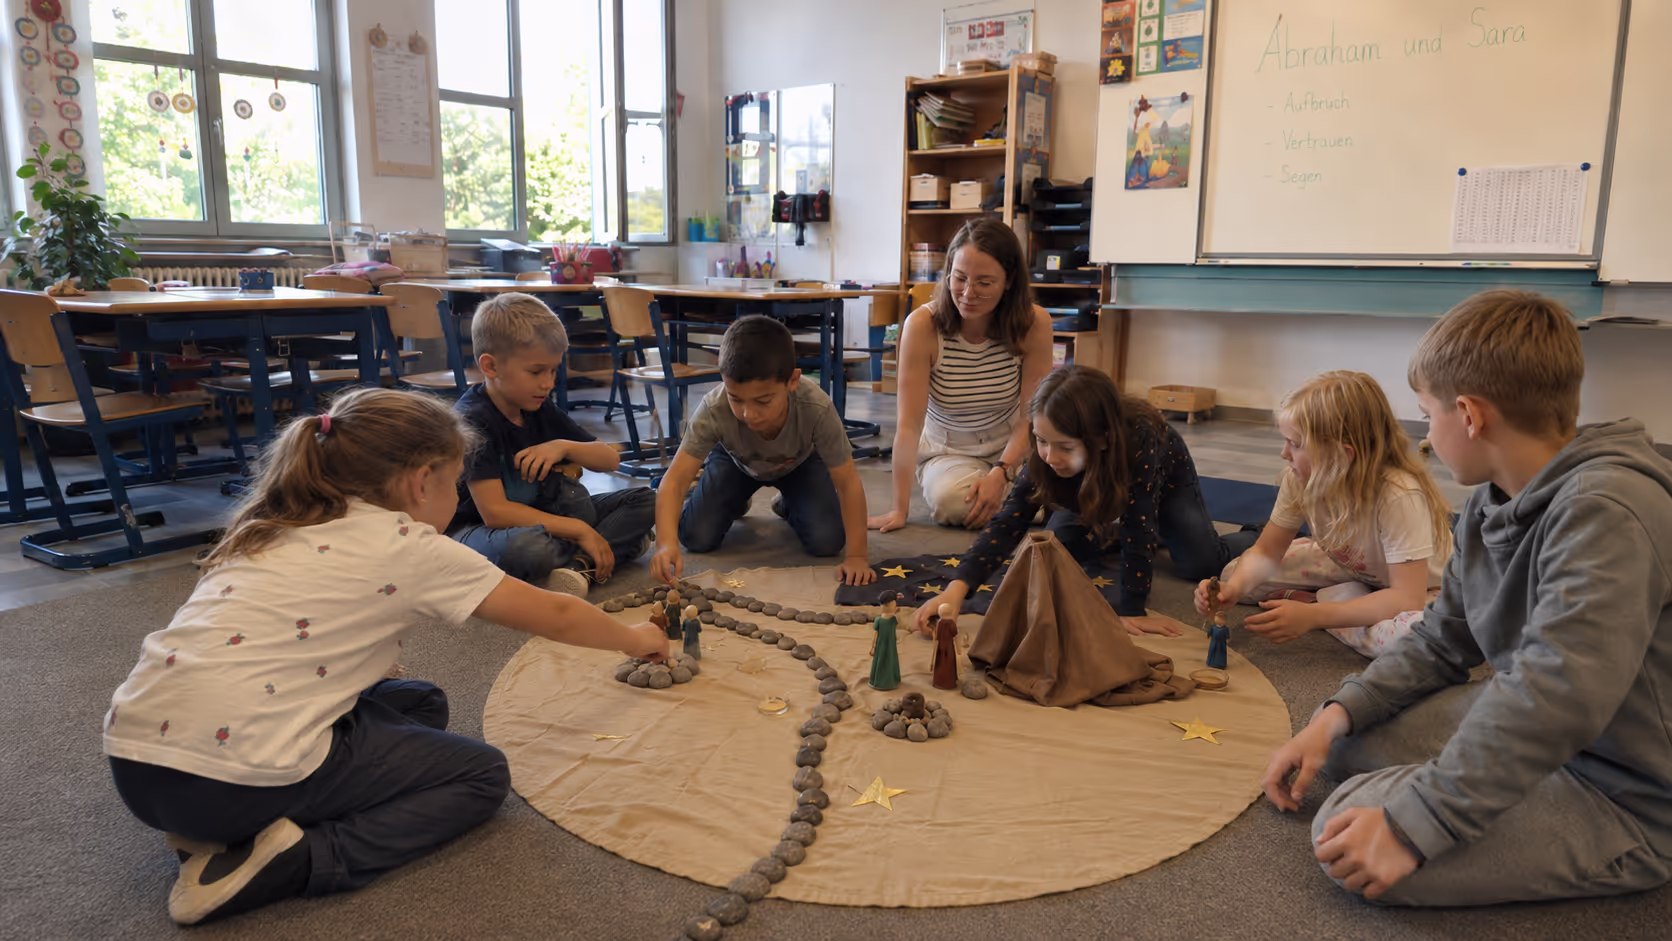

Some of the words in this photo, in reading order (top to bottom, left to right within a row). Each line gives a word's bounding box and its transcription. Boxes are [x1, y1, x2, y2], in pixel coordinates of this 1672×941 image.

[1253, 12, 1382, 74] Abraham
[1403, 21, 1443, 58] und
[1466, 6, 1528, 48] Sara
[1284, 90, 1350, 114] Aufbruch
[1282, 128, 1353, 152] Vertrauen
[1279, 164, 1322, 189] Segen
